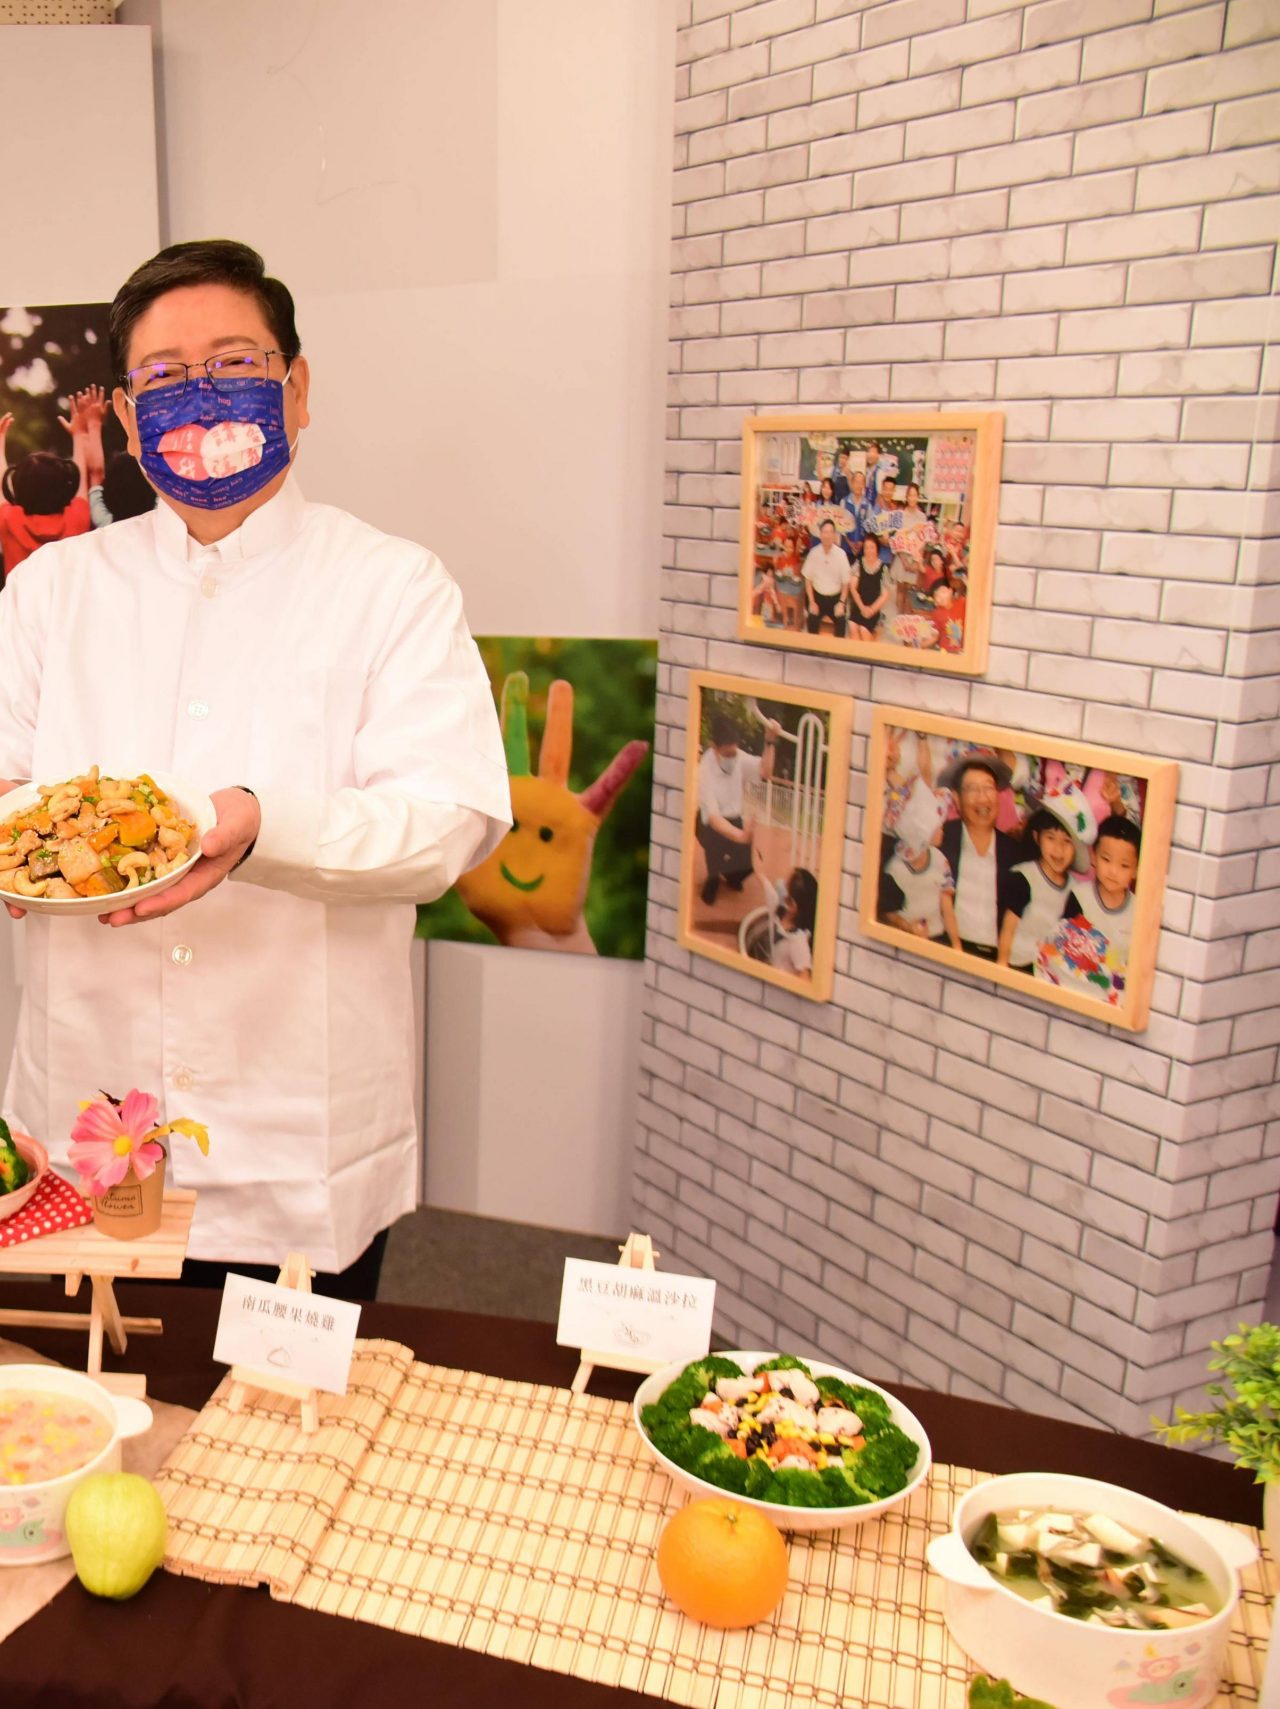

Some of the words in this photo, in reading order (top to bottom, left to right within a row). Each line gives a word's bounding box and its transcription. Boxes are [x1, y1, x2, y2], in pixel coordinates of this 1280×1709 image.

[103, 1191, 136, 1201] utumn
[242, 1294, 336, 1331] 南瓜腰果燒雞
